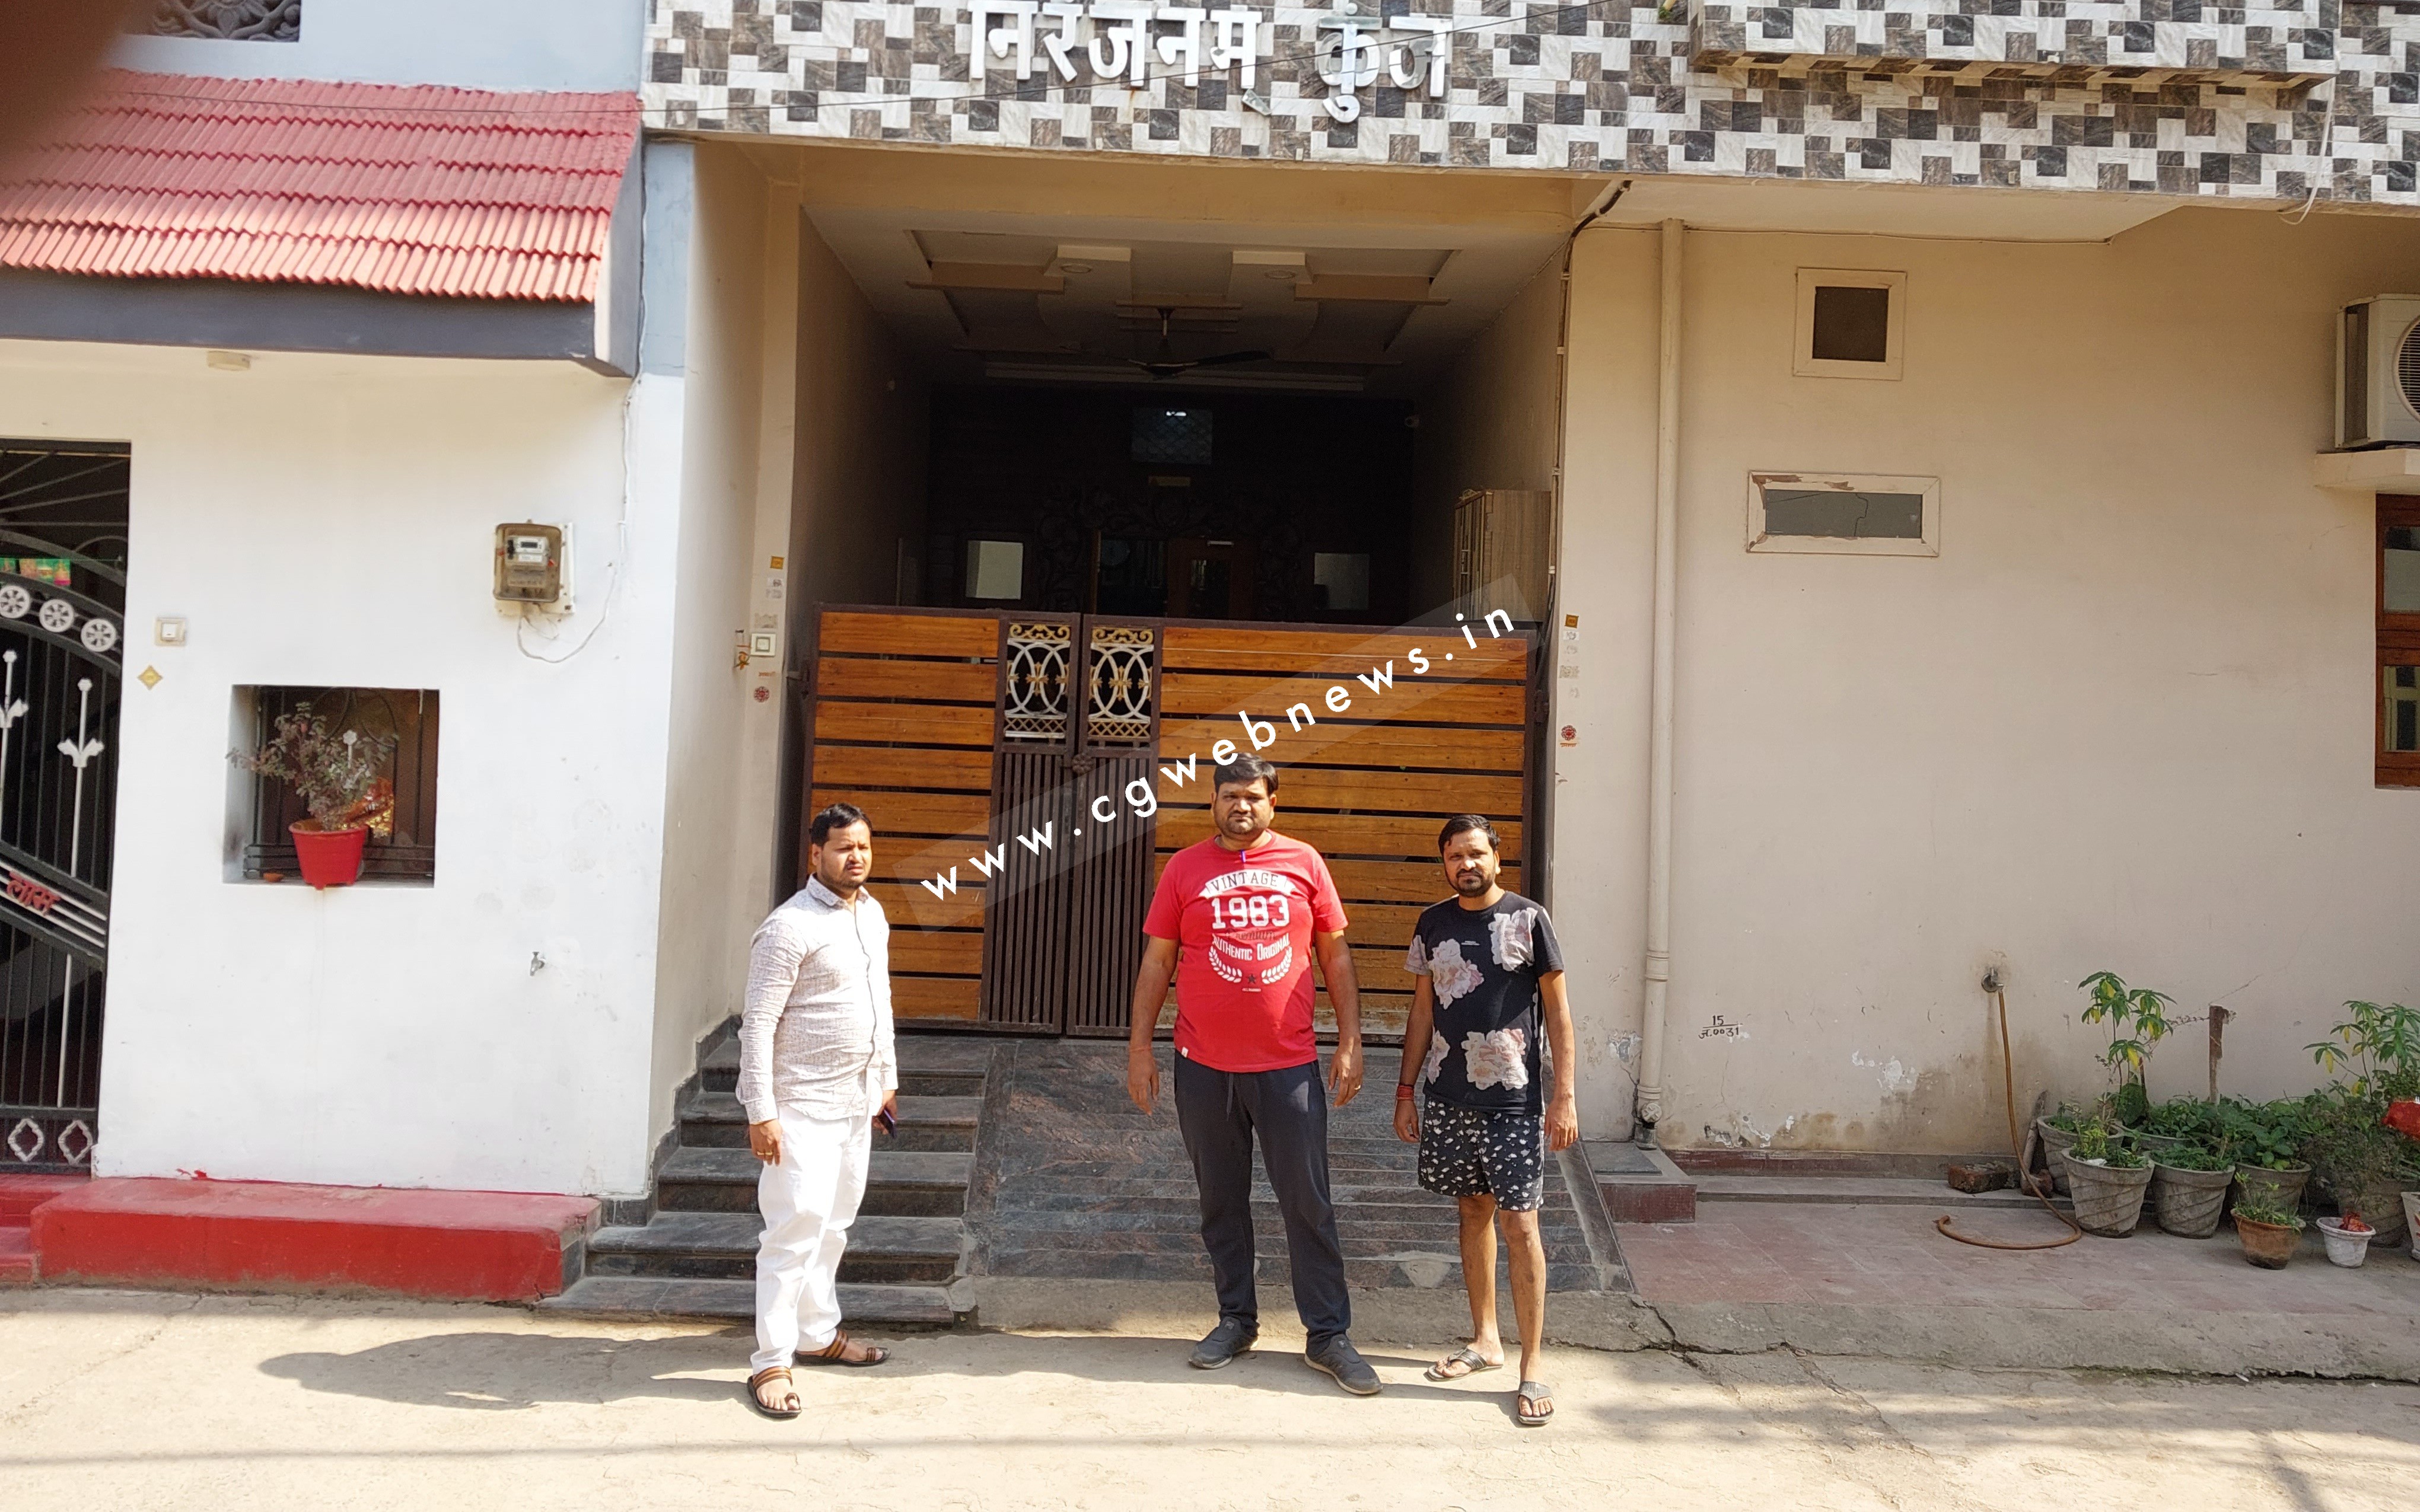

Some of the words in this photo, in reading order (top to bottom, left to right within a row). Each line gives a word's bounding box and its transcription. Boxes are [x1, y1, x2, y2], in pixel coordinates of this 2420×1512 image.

[1318, 2, 1453, 123] कुंज
[1211, 871, 1279, 891] VINTAGE
[1211, 894, 1290, 929] 1983
[1712, 1015, 1724, 1026] 15
